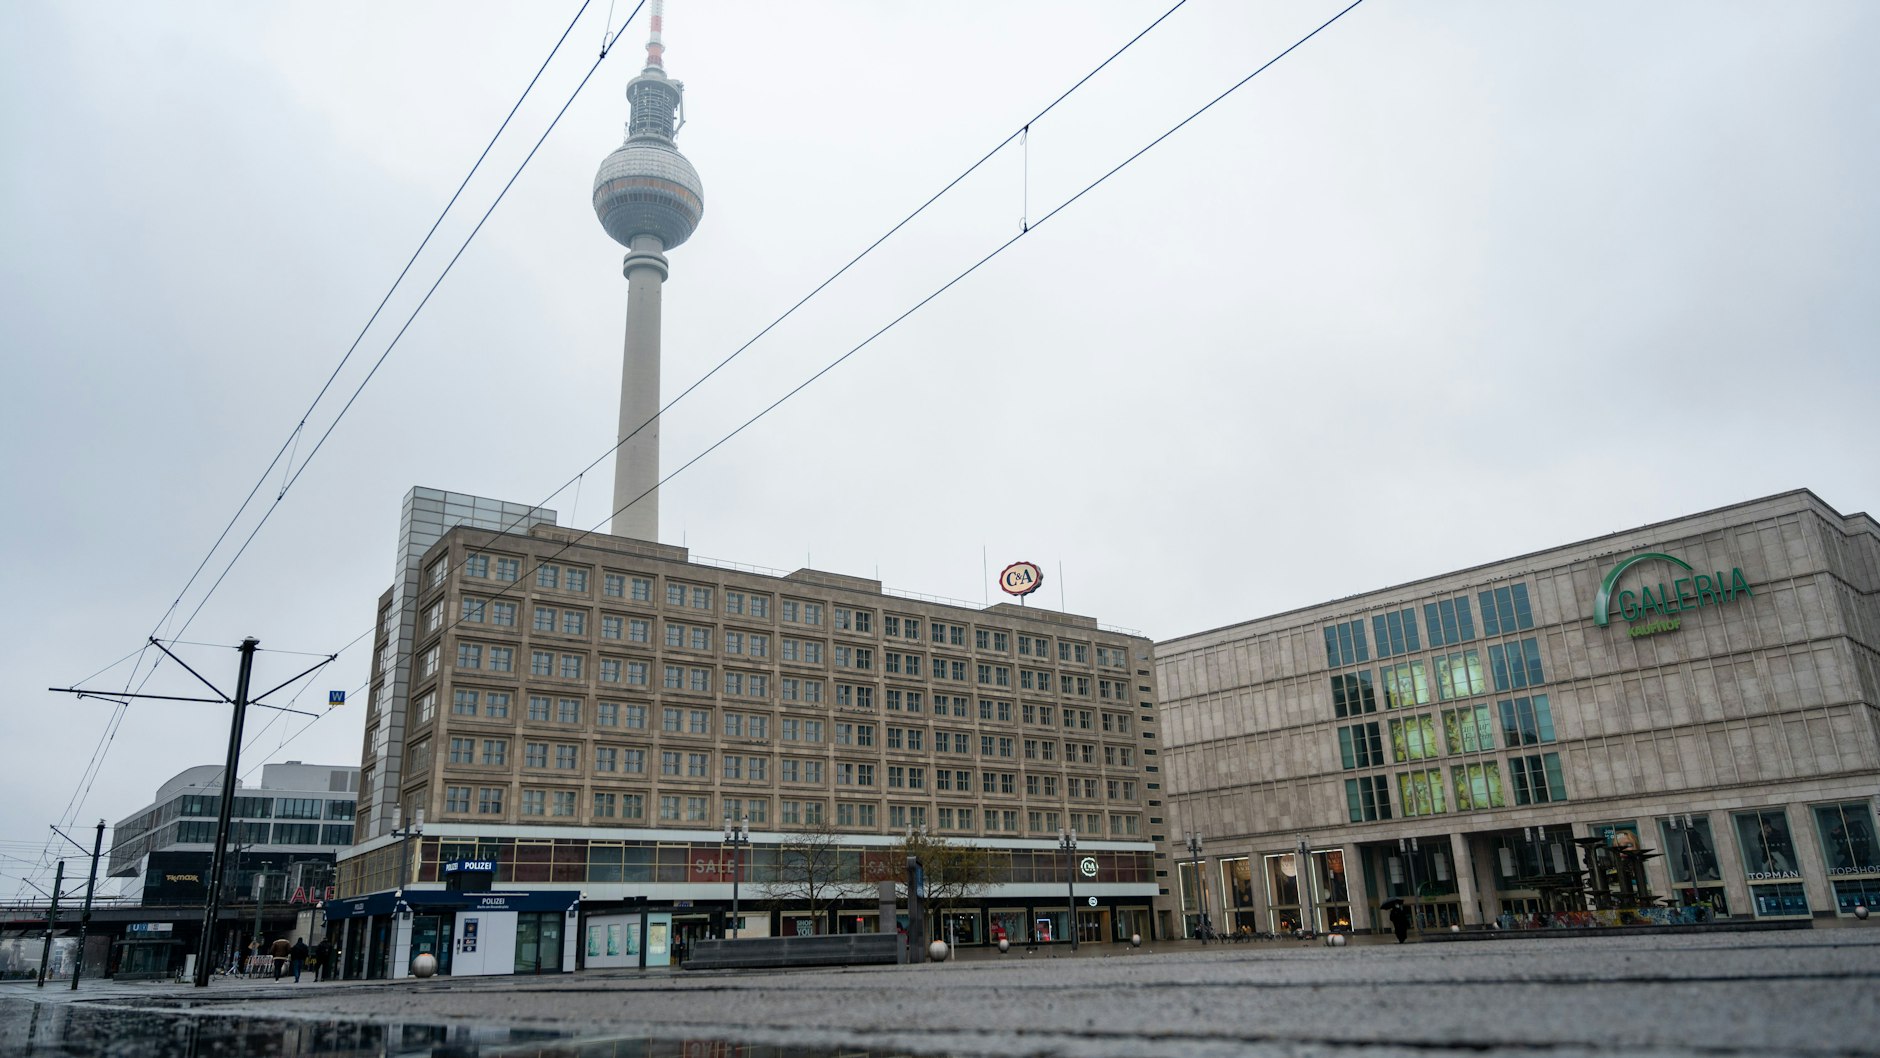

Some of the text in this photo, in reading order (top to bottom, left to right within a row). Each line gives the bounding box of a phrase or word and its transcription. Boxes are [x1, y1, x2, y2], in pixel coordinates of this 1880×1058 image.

[1006, 568, 1033, 587] C&A
[1618, 567, 1753, 623] GALERIA
[331, 691, 344, 702] W
[464, 861, 493, 870] POLIZEI
[694, 859, 735, 874] SALE
[1747, 870, 1800, 880] TOPMAN
[482, 897, 506, 905] POLIZEI
